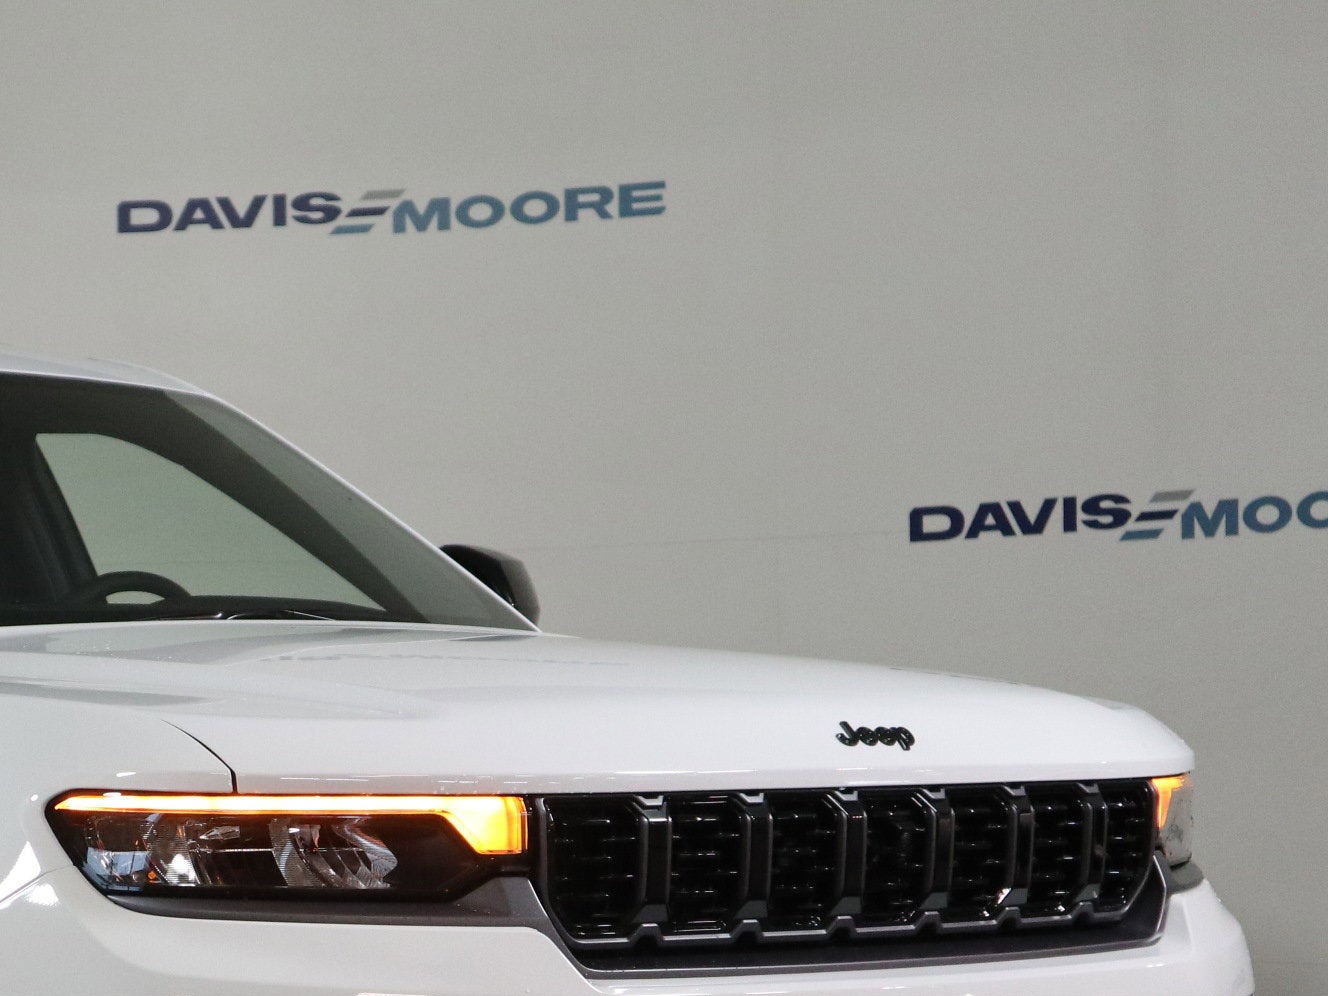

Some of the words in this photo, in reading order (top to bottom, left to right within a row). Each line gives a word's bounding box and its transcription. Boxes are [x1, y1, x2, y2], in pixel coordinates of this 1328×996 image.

[117, 191, 342, 233] DAVIS
[392, 180, 667, 235] MOORE
[909, 494, 1132, 542] DAVIS
[835, 721, 915, 751] Jeep
